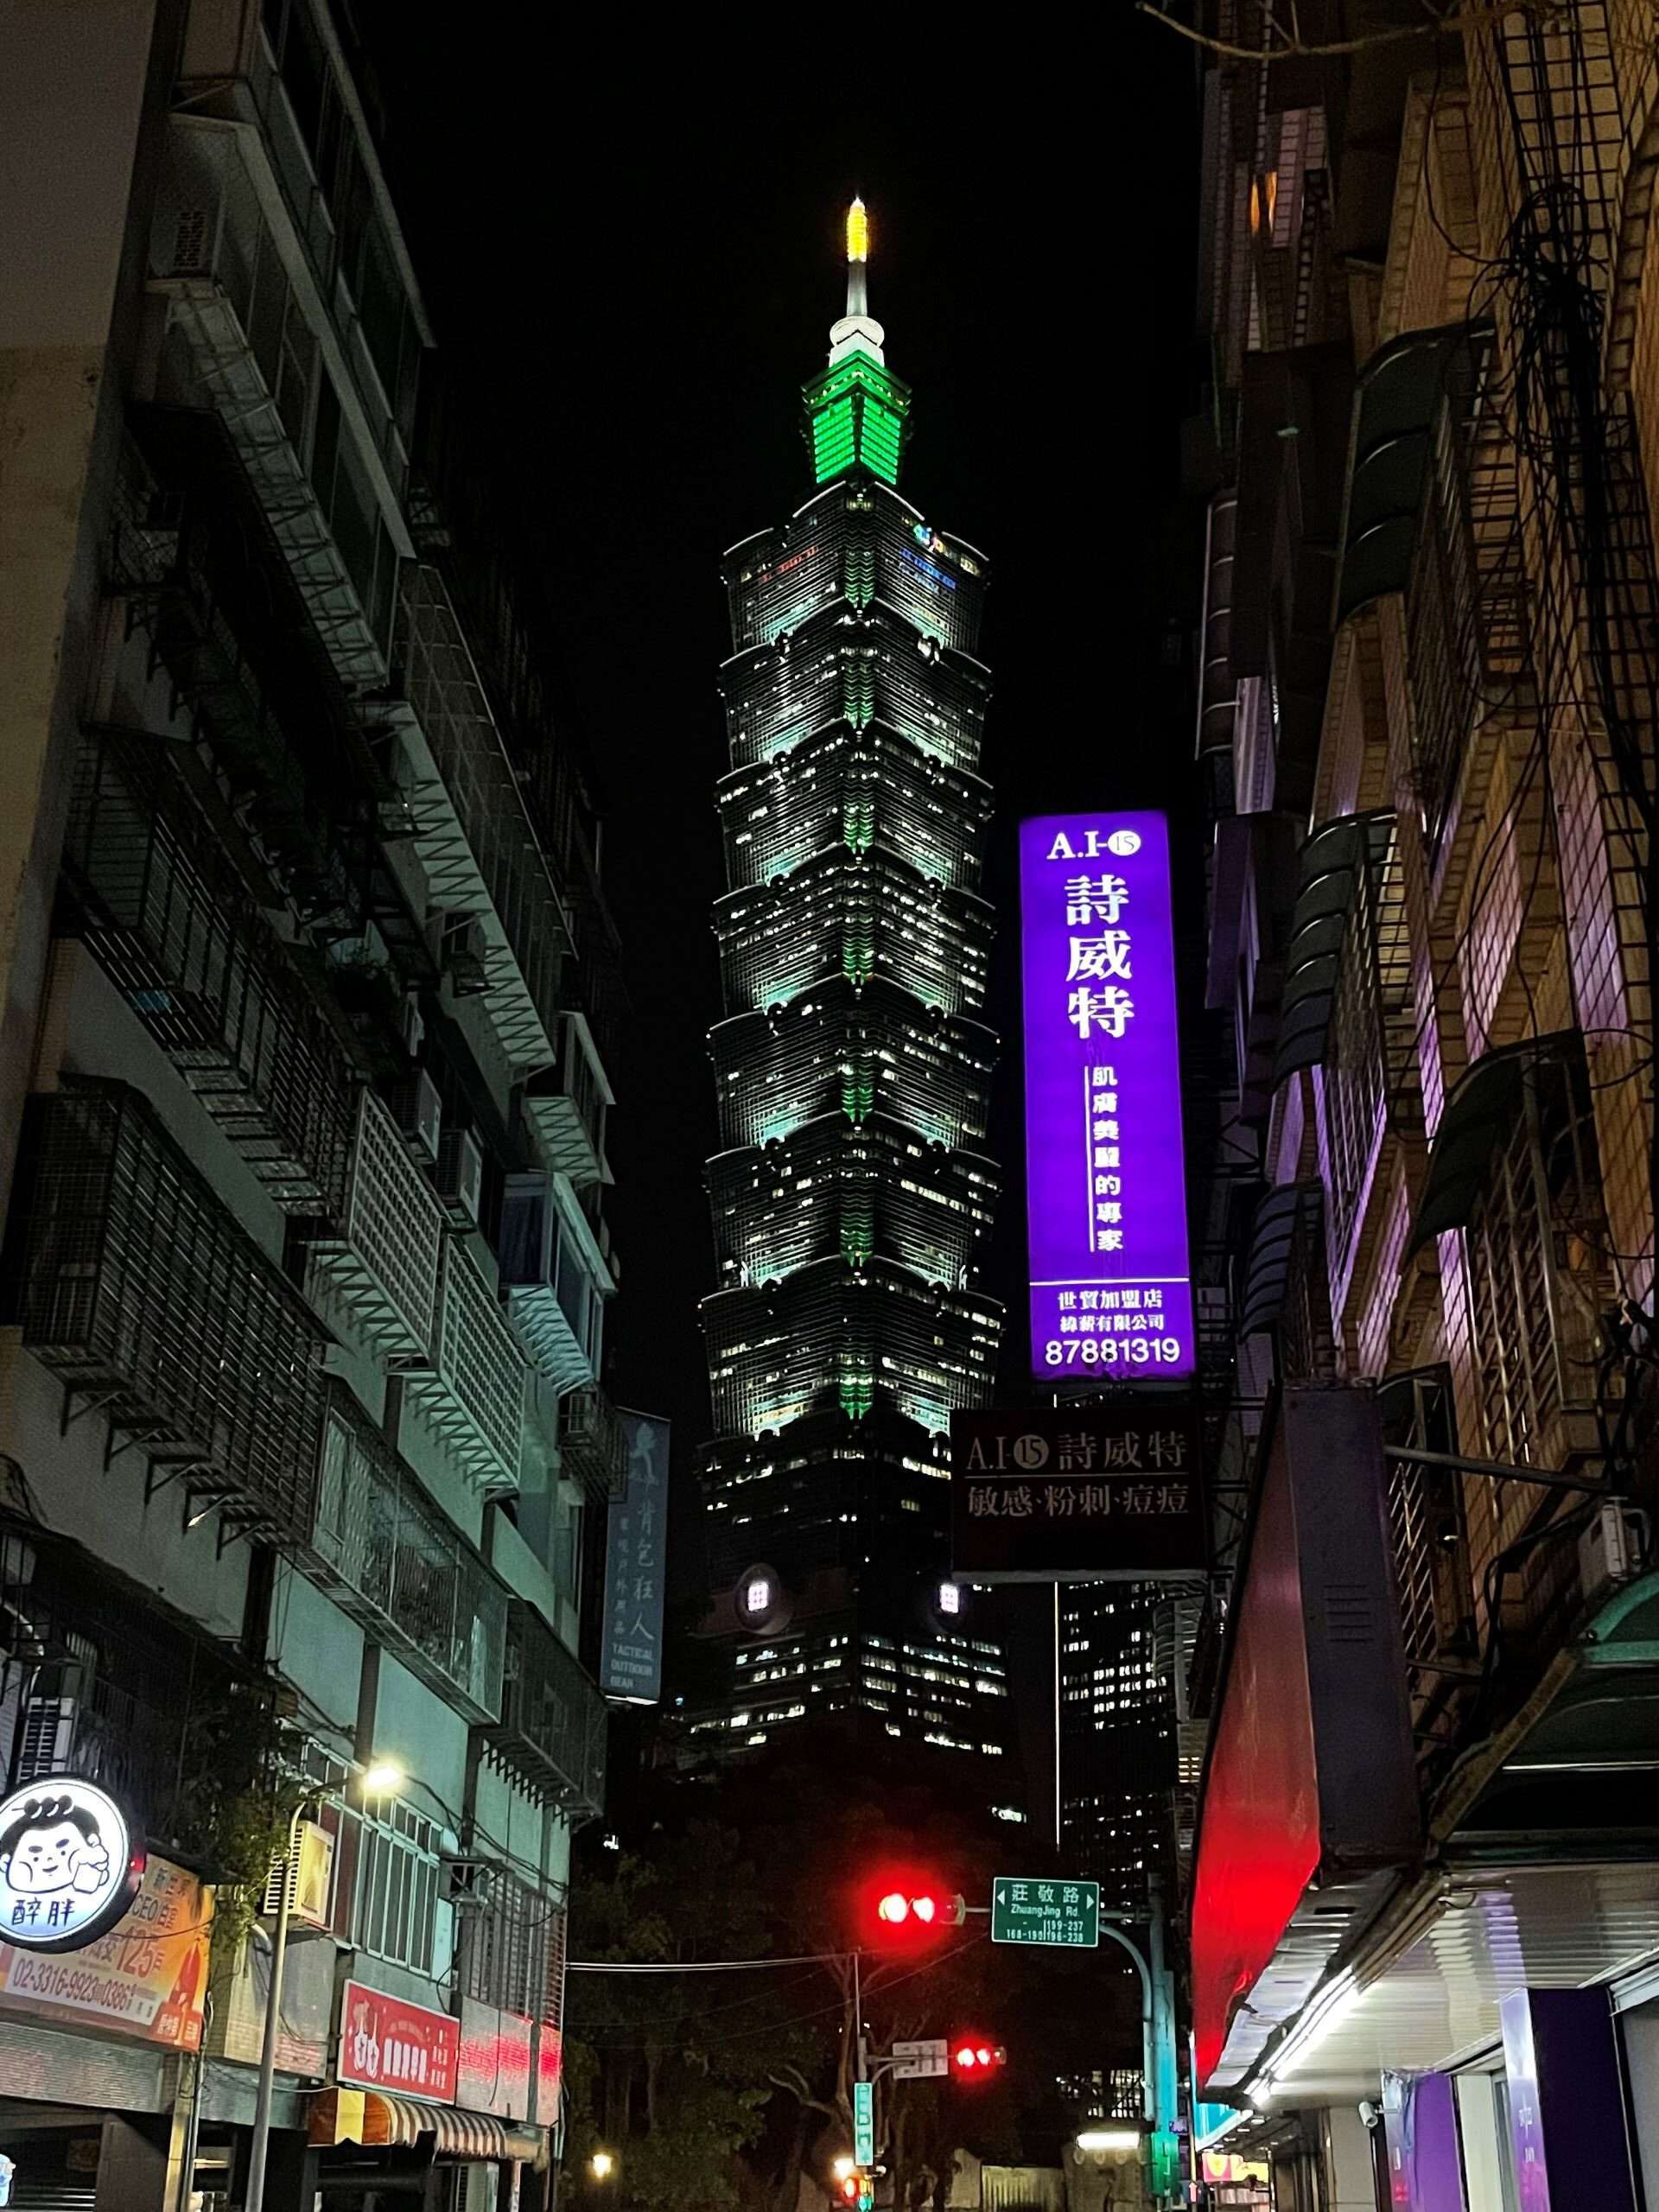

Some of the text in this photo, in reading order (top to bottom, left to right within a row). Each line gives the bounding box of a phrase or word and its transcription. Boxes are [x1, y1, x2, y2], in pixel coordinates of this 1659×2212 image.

[1065, 874, 1135, 1039] 詩威特
[1058, 1289, 1162, 1311] 世貿加盟店
[1045, 1338, 1180, 1365] 87881319
[1057, 1431, 1188, 1470] 詩威特
[630, 1499, 656, 1640] 背包狂人
[132, 1893, 159, 1922] CEO
[1011, 1884, 1080, 1904] 莊敬路
[11, 1897, 75, 1927] 醉胖
